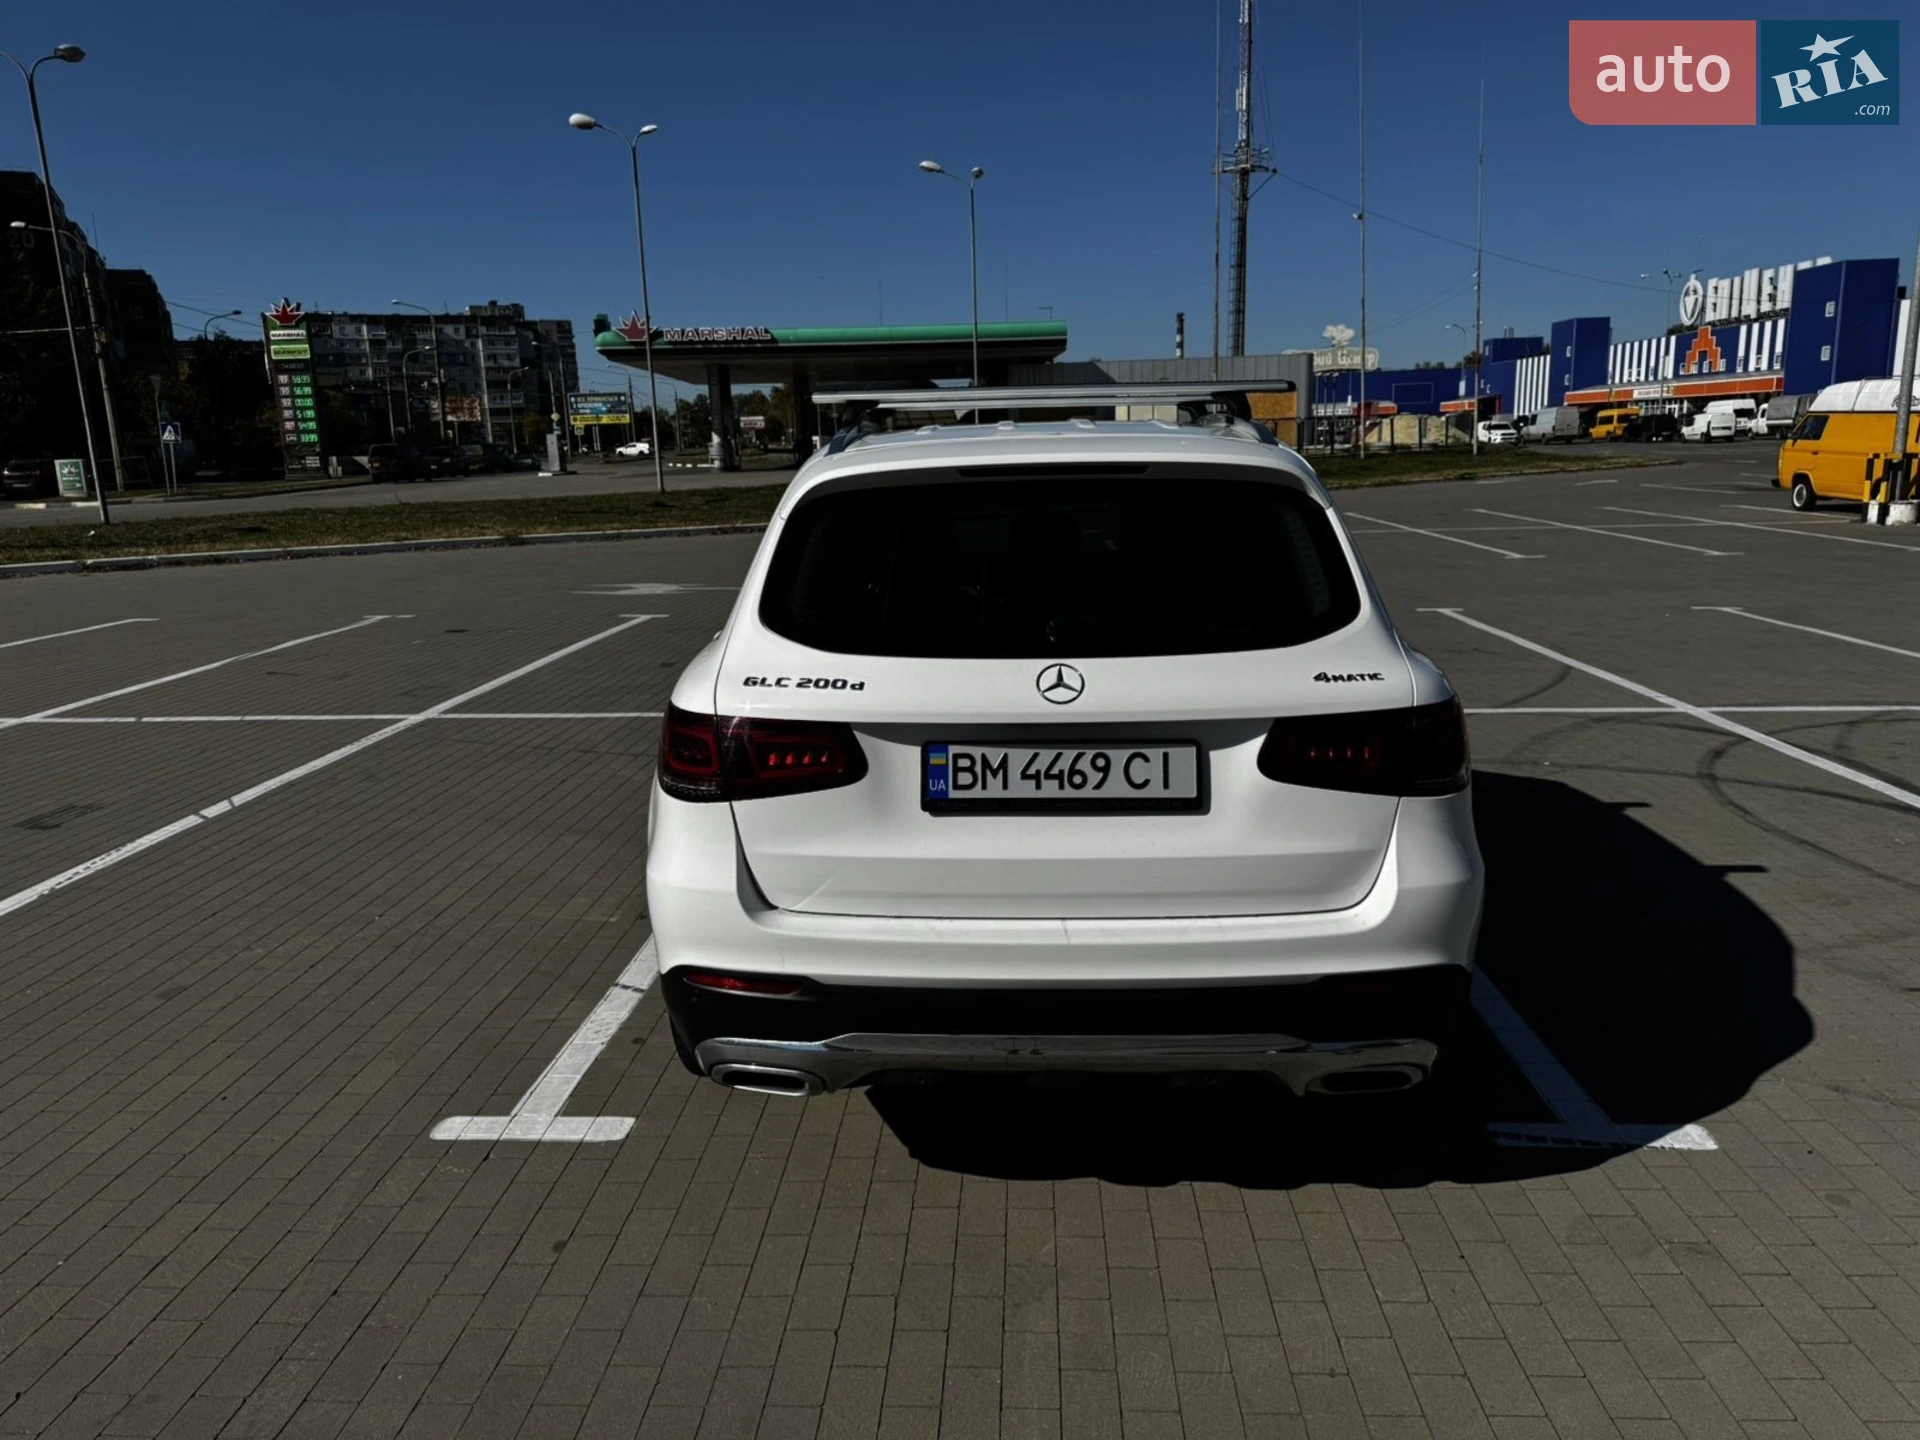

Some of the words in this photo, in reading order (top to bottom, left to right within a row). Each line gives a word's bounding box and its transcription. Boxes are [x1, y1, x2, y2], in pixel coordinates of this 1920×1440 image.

[663, 326, 771, 341] MARSHAL
[742, 676, 792, 688] GLC
[1312, 671, 1385, 683] 4MATIC
[951, 752, 1009, 790] BM
[1020, 752, 1112, 790] 4469
[928, 778, 947, 791] UA
